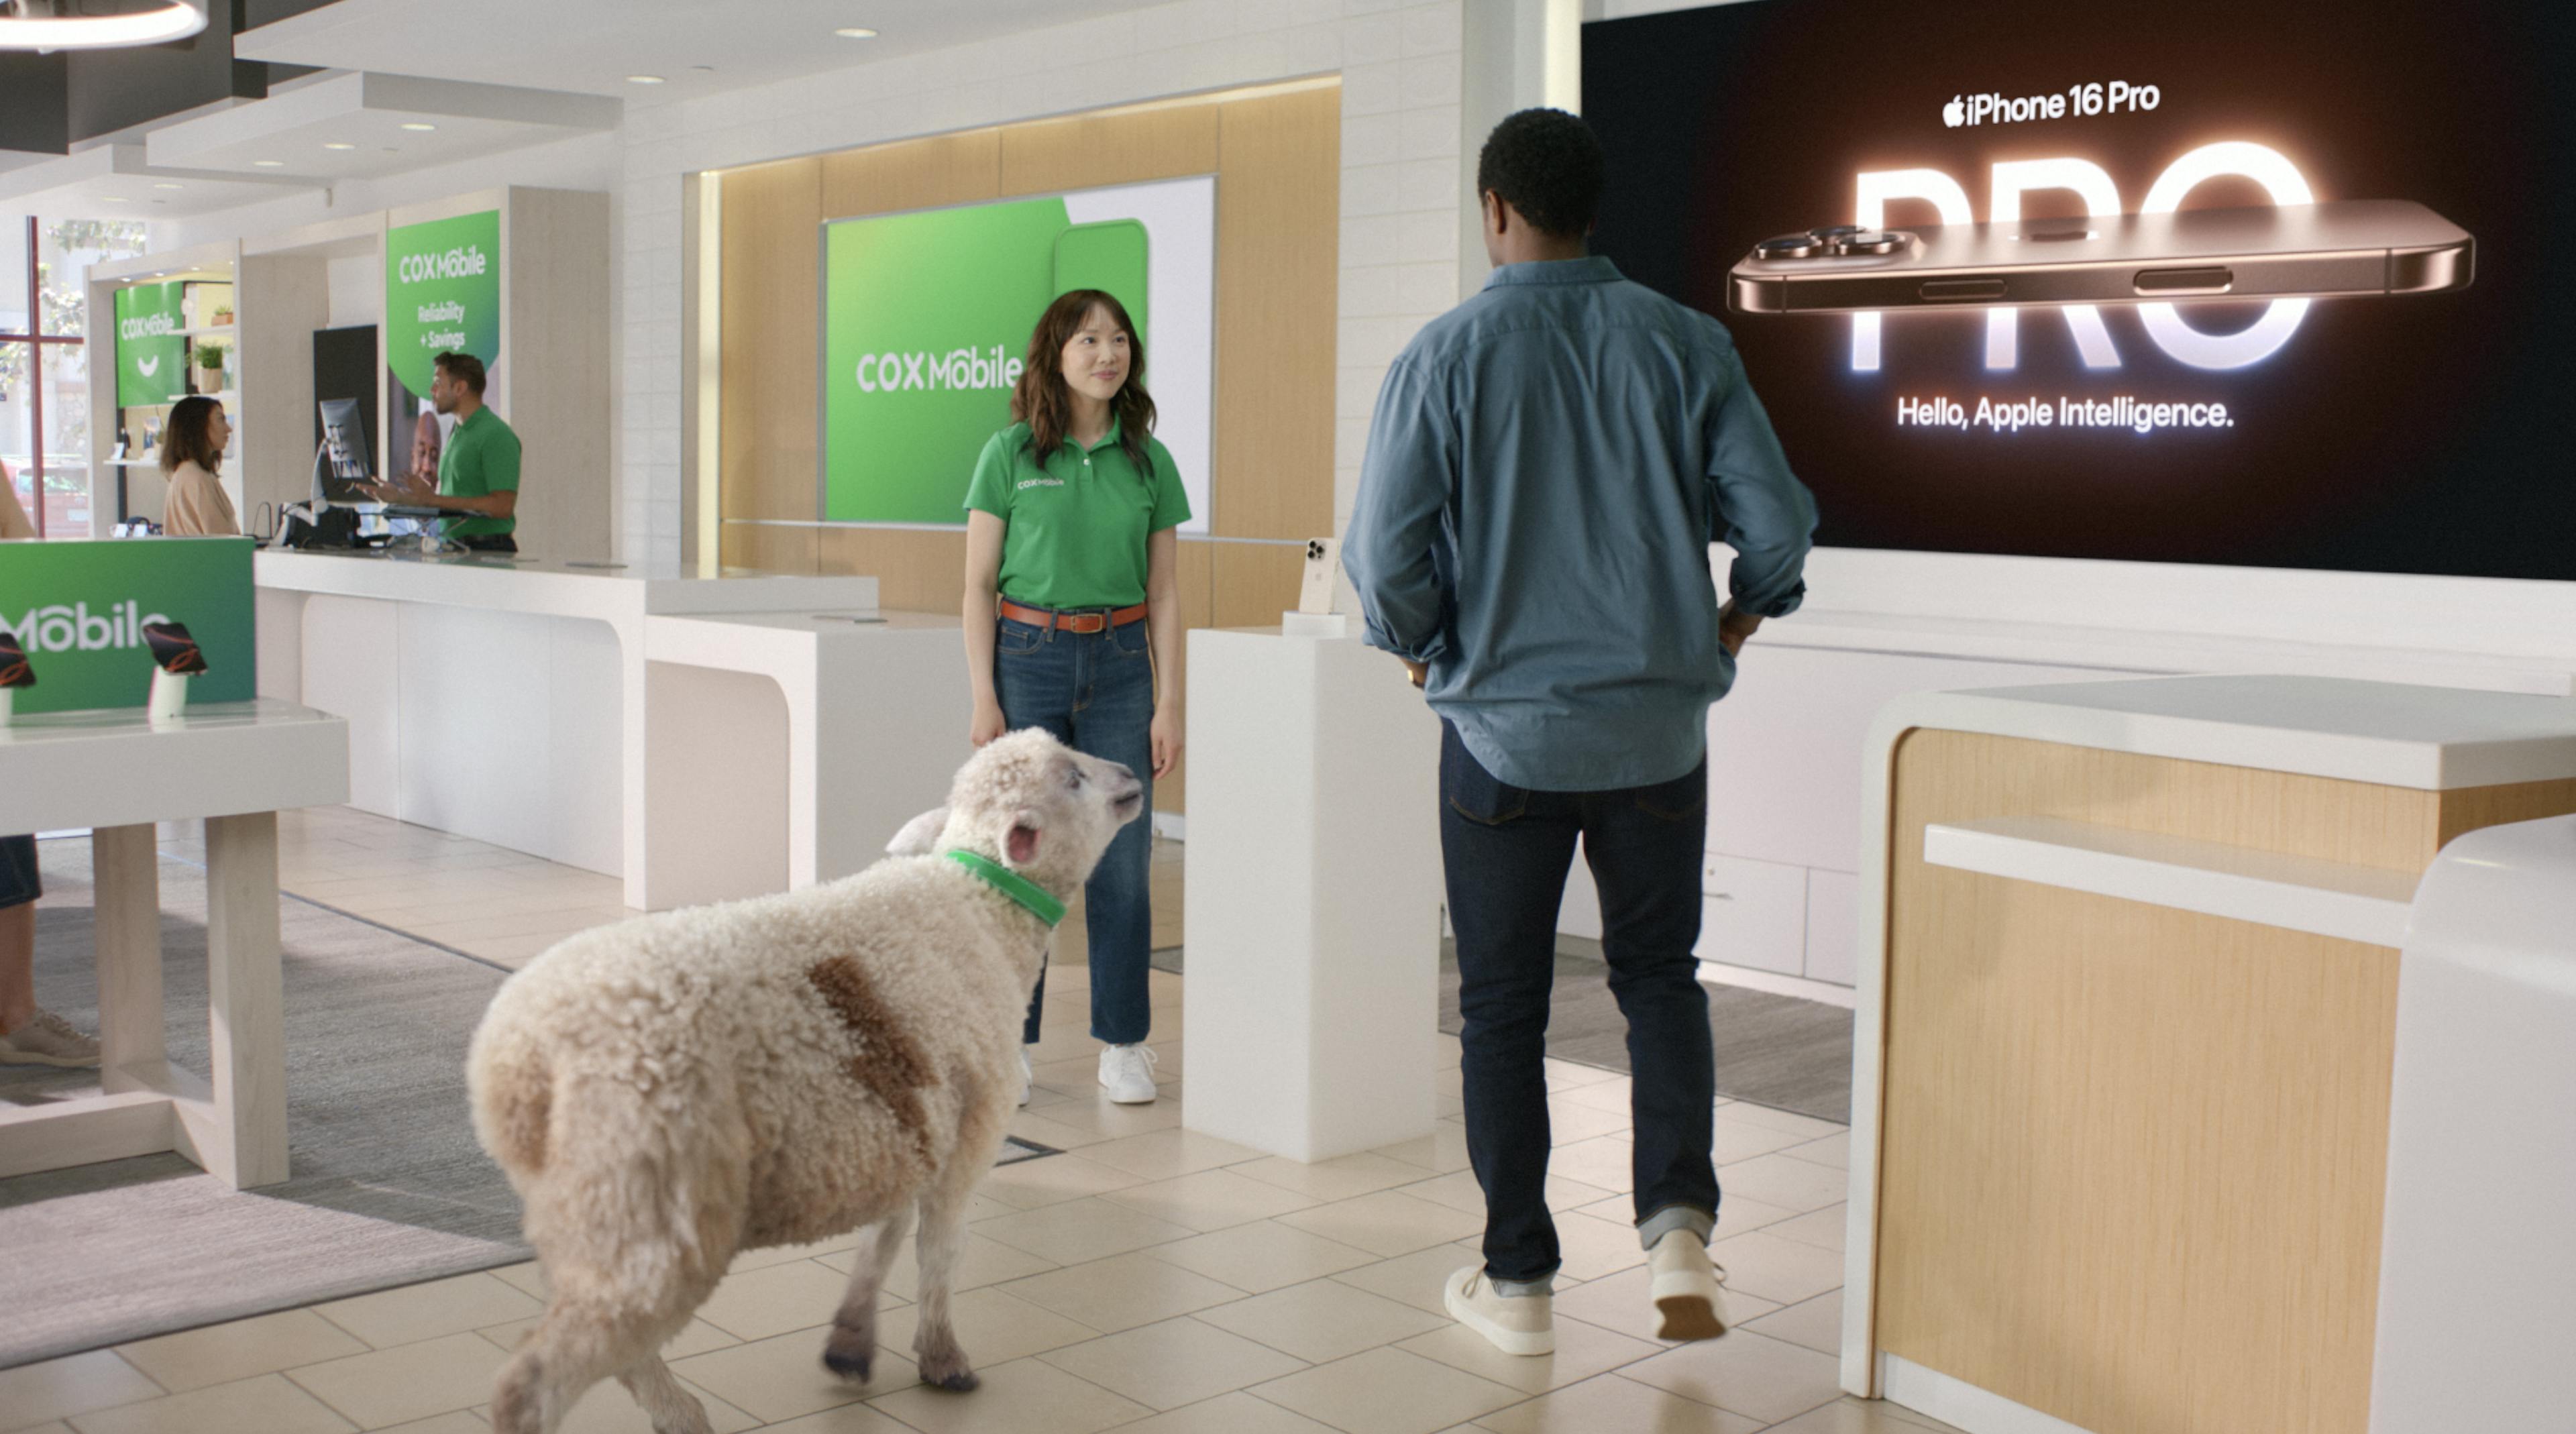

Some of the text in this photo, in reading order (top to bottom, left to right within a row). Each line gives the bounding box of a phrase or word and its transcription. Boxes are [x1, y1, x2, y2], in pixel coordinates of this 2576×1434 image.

[1966, 80, 2160, 127] iPhone 16 Pro
[1852, 141, 2314, 371] PRO
[418, 300, 466, 325] Reliability
[428, 327, 466, 351] Savings
[1896, 396, 2235, 433] Hello, Apple Intelligence.
